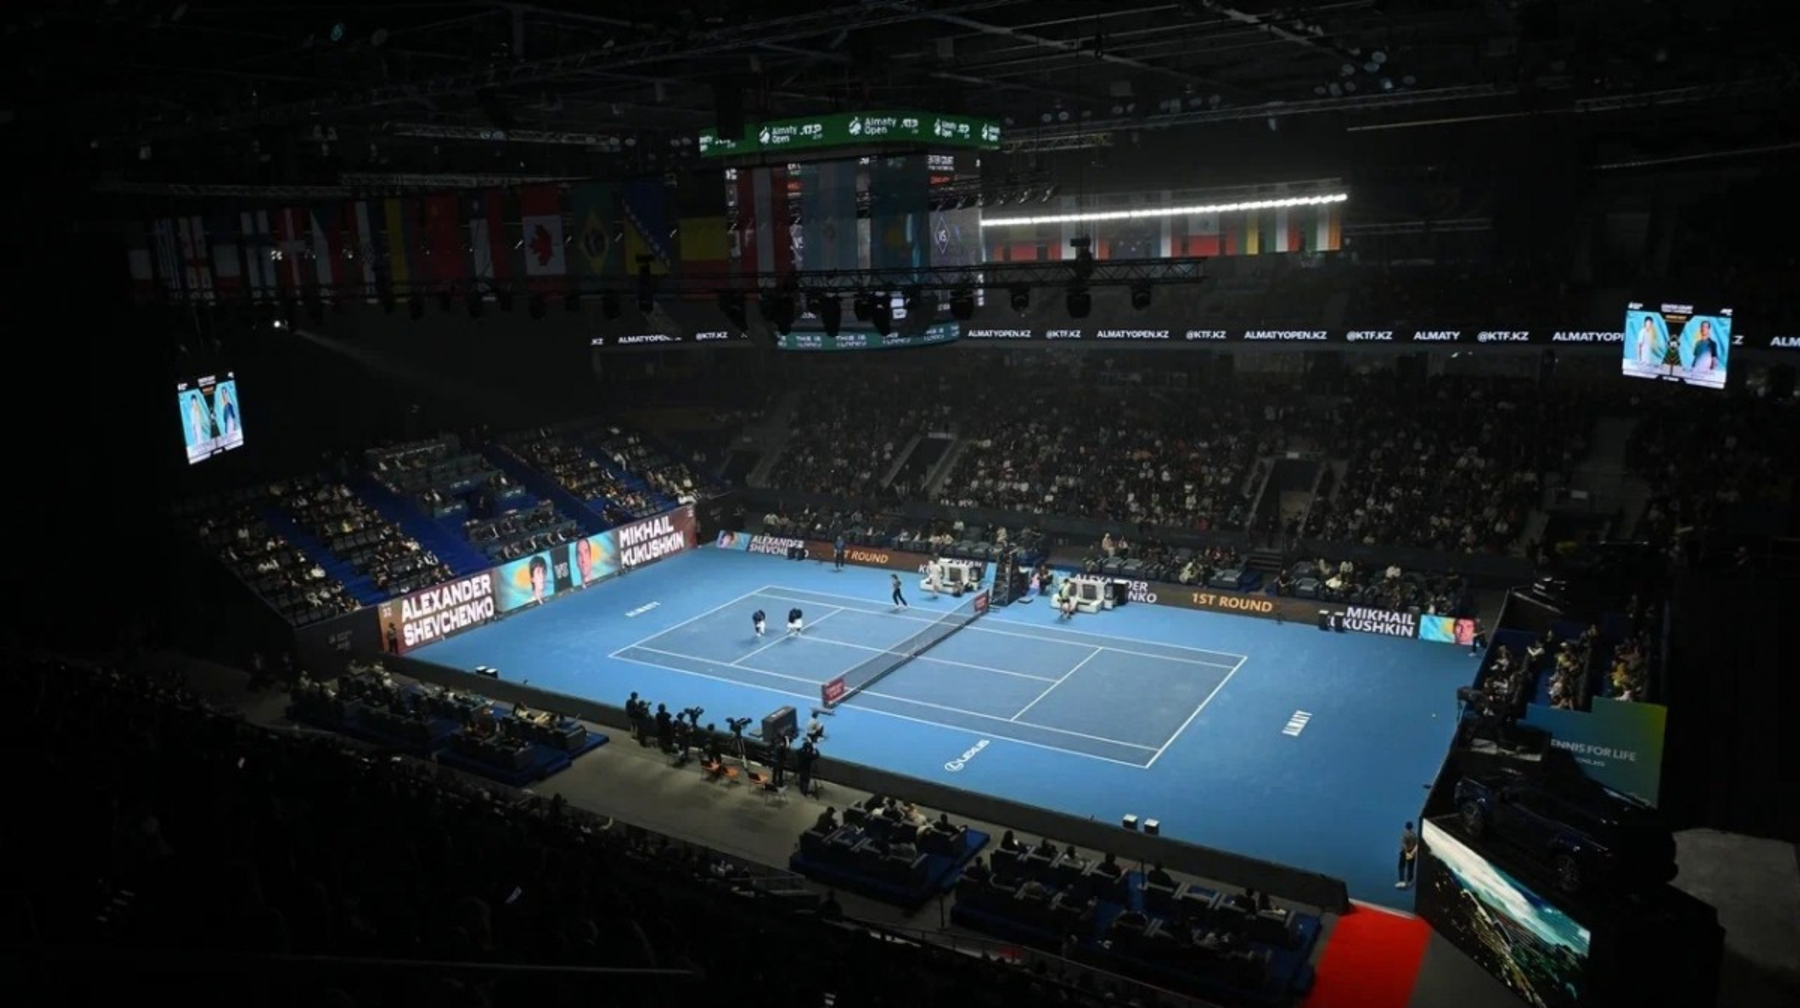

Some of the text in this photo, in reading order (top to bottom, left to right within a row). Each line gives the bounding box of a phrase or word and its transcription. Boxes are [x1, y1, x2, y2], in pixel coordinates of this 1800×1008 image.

[771, 126, 797, 136] Almaty
[864, 117, 897, 128] Almaty
[864, 126, 888, 135] Open
[771, 135, 790, 144] Open
[968, 330, 1032, 339] ALMATYOPEN.KZ
[1046, 330, 1082, 340] @KTF.KZ
[1097, 330, 1170, 339] ALMATYOPEN.KZ
[1185, 330, 1227, 341] @KTF.KZ
[1244, 331, 1328, 340] ALMATYOPEN.KZ
[1346, 330, 1393, 342] @KTF.KZ
[1413, 331, 1461, 341] ALMATY
[1478, 330, 1530, 343] @KTF.KZ
[1552, 331, 1625, 342] ALMATYOP
[619, 516, 675, 549] MIKHAIL
[621, 531, 684, 568] KUKUSHKIN
[752, 535, 804, 549] ALEXANDER
[851, 551, 889, 564] ROUND
[554, 562, 569, 579] VS
[401, 573, 493, 623] ALEXANDER
[1191, 592, 1273, 613] 1ST ROUND
[403, 596, 495, 647] SHEVCHENKO
[1347, 606, 1416, 626] MIKHAIL
[1281, 709, 1313, 737] ALMATY
[1550, 738, 1586, 754] ENNIS
[1587, 745, 1611, 757] FOR
[1613, 749, 1637, 762] LIFE
